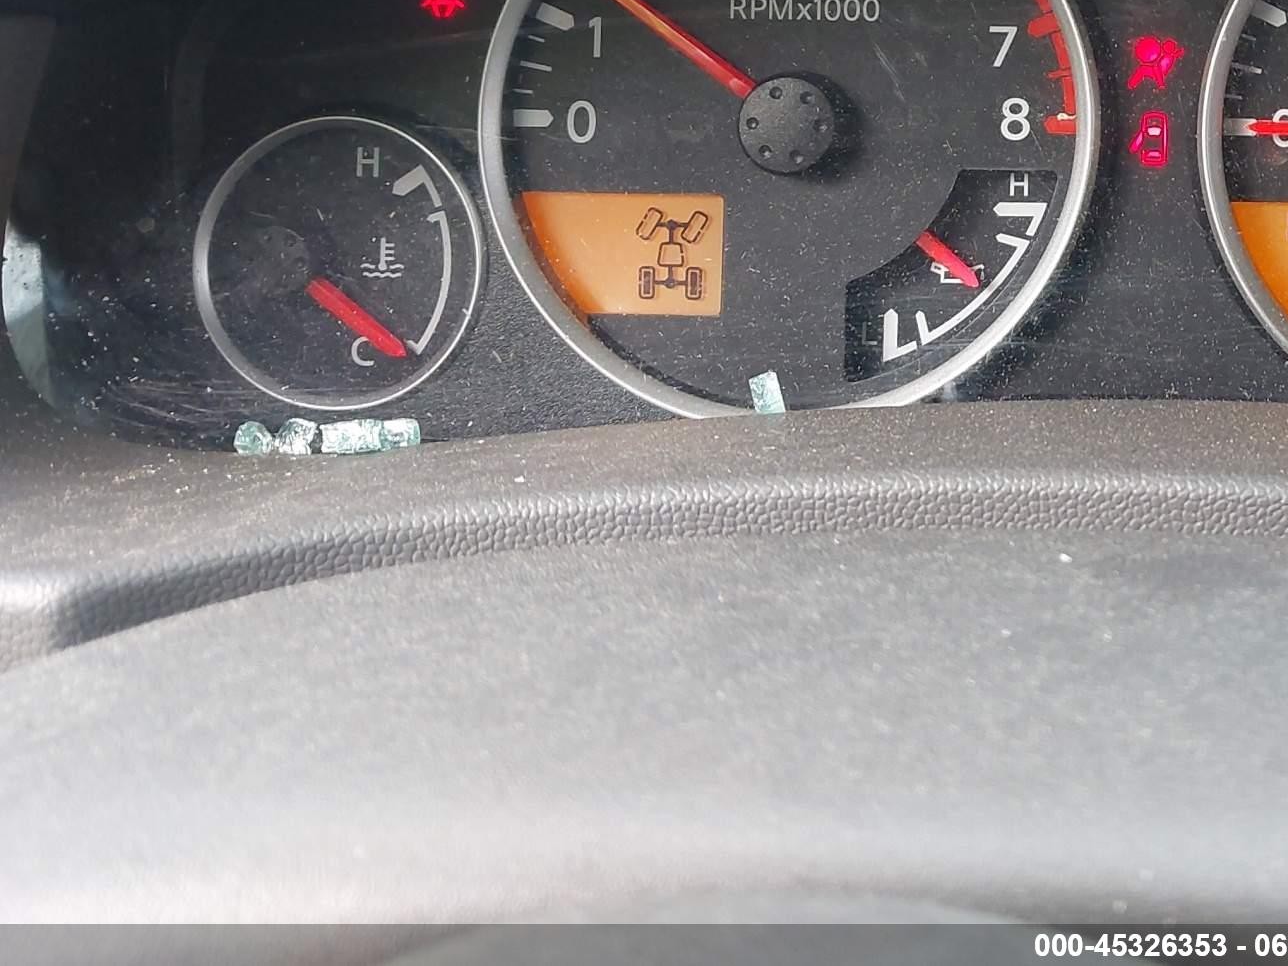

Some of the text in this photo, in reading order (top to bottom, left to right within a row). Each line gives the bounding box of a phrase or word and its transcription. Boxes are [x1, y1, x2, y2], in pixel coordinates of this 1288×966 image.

[589, 17, 601, 57] 1
[990, 26, 1017, 67] 7
[567, 101, 596, 143] 0
[1001, 98, 1030, 140] 8
[357, 147, 379, 177] H
[1010, 174, 1028, 196] H
[351, 337, 375, 367] C
